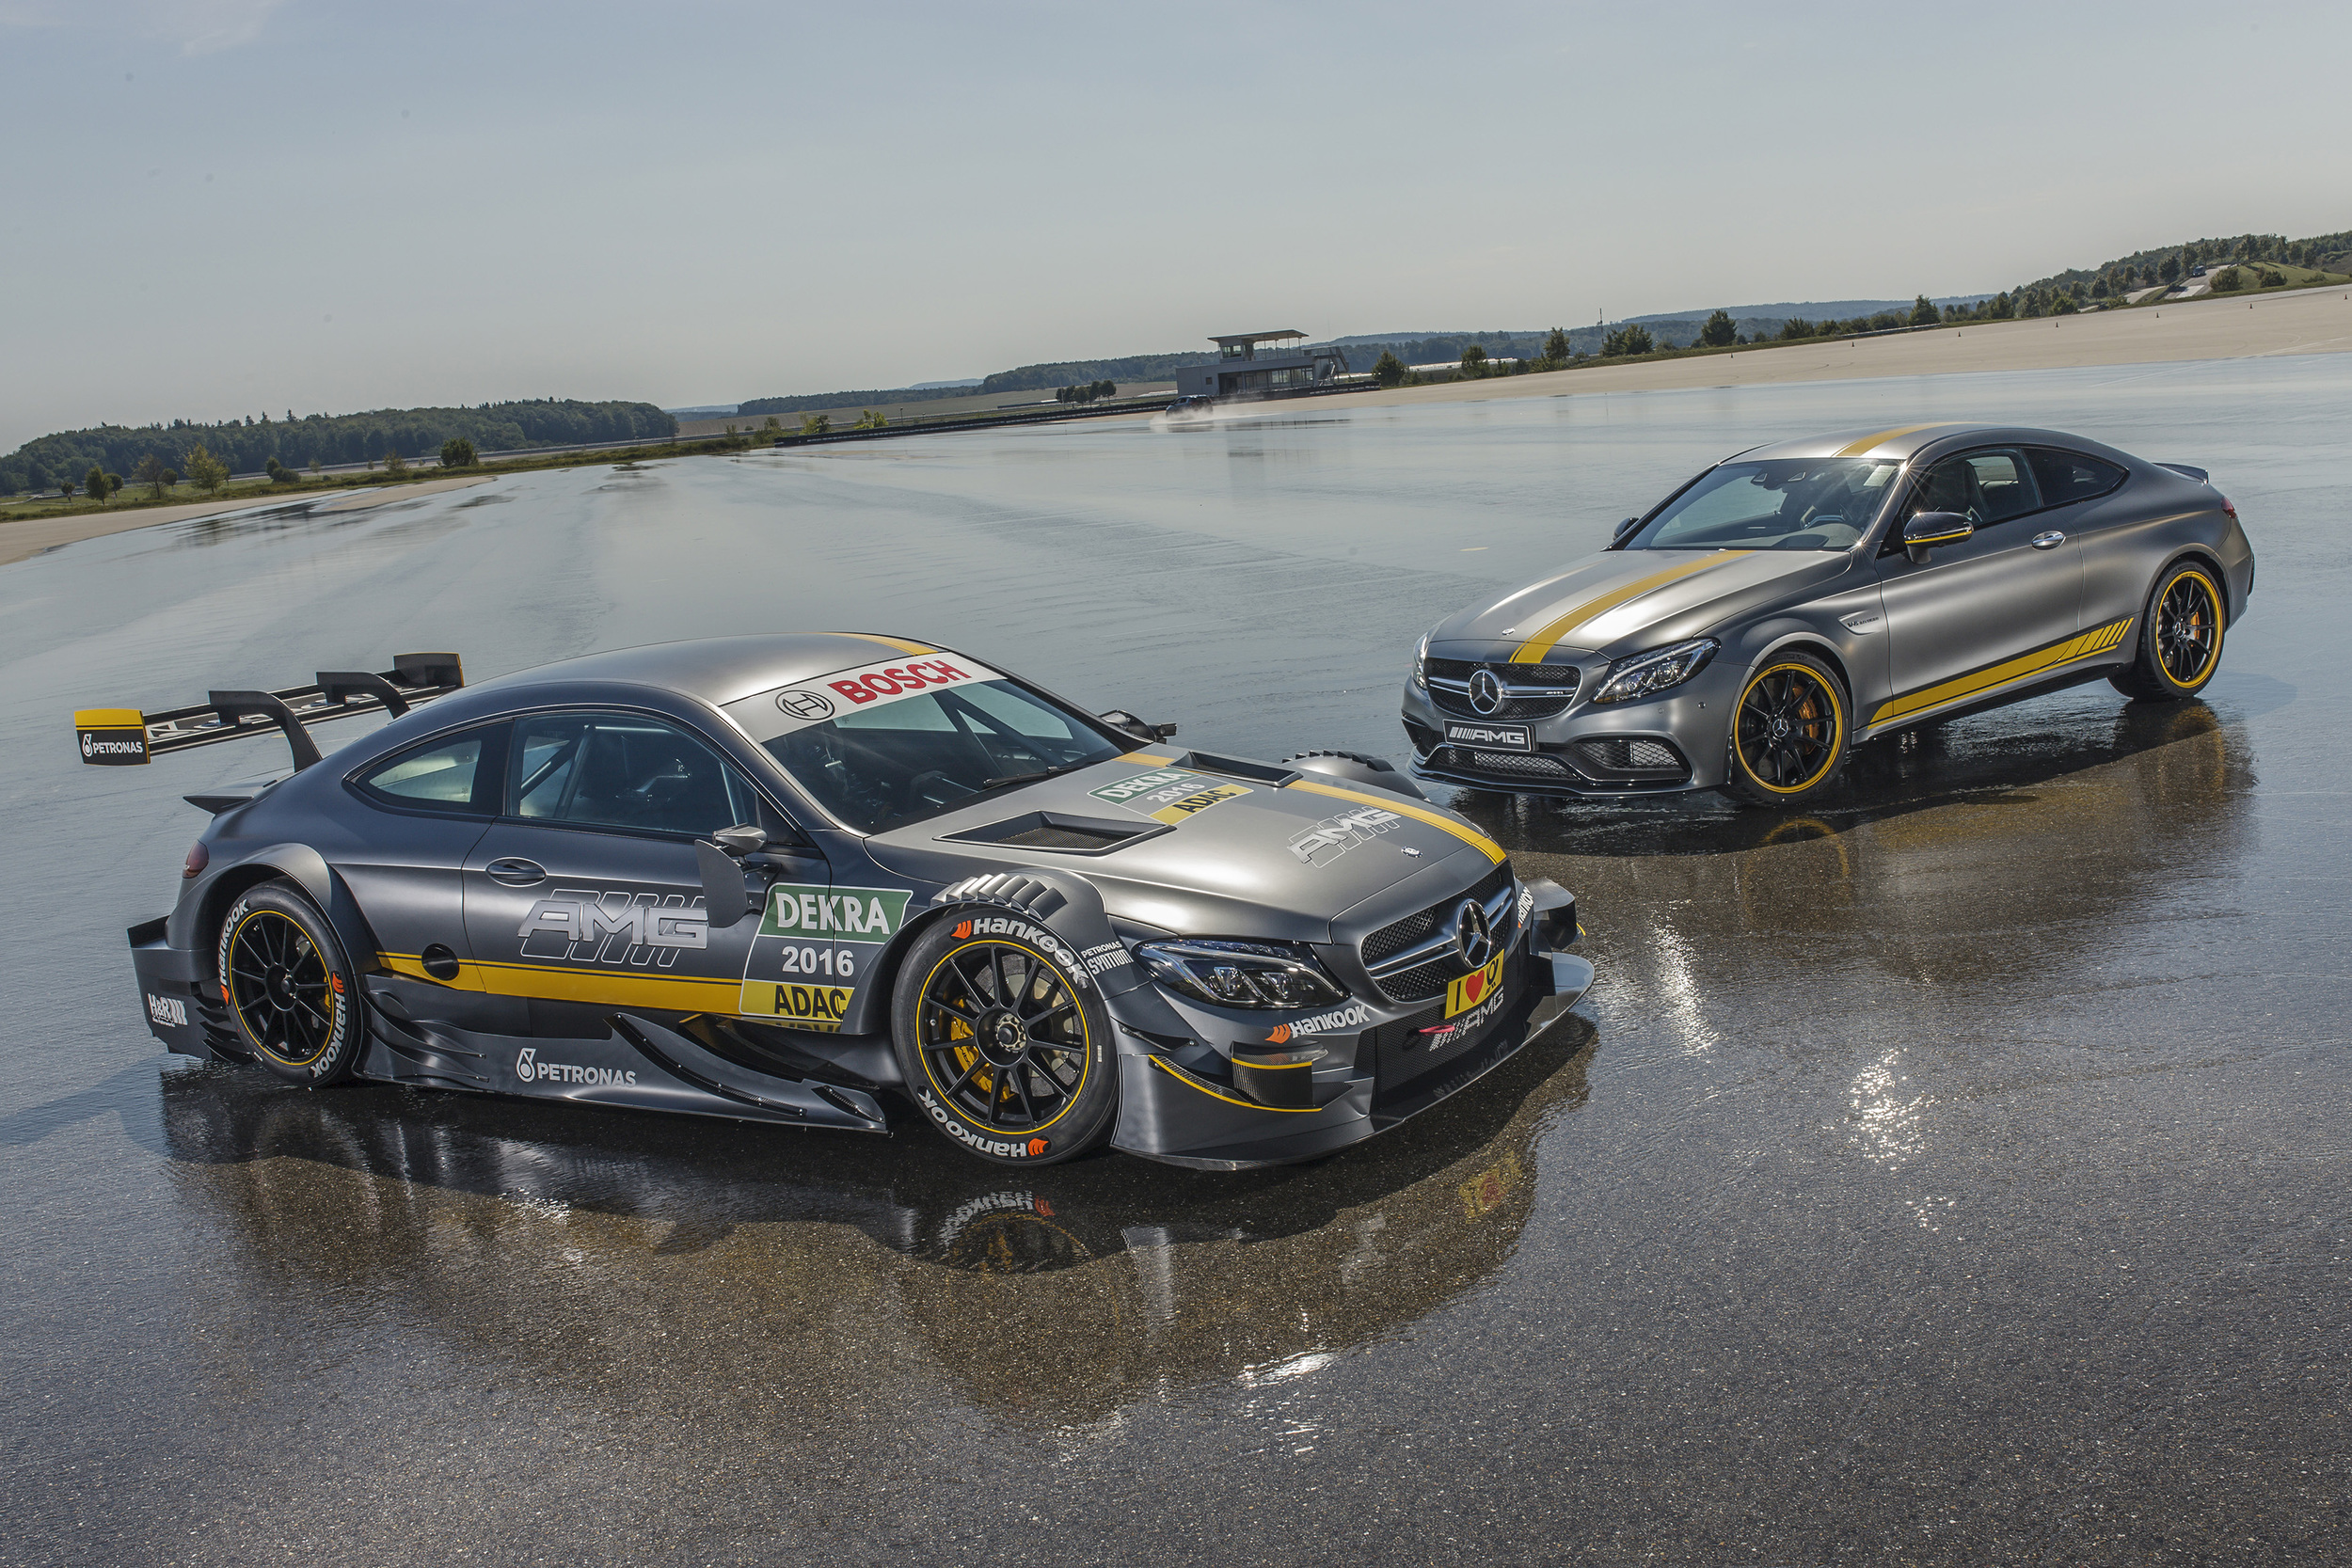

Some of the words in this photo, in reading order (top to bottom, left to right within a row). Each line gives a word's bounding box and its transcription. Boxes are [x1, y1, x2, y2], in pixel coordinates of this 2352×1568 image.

[827, 659, 972, 705] BOSCH
[92, 741, 144, 754] PETRONAS
[1470, 728, 1525, 745] AMG
[1097, 771, 1192, 799] DEKRA
[1146, 783, 1206, 803] 2016
[1172, 789, 1237, 814] ADAC
[1286, 808, 1402, 864] AMG
[517, 899, 708, 950] AMG
[774, 892, 891, 935] DEKRA
[782, 945, 854, 977] 2016
[1081, 941, 1122, 958] PETRONAS
[1087, 949, 1134, 974] SYNTIUM
[773, 984, 847, 1021] ADAC
[1462, 986, 1504, 1037] AMG
[536, 1062, 637, 1087] PETRONAS
